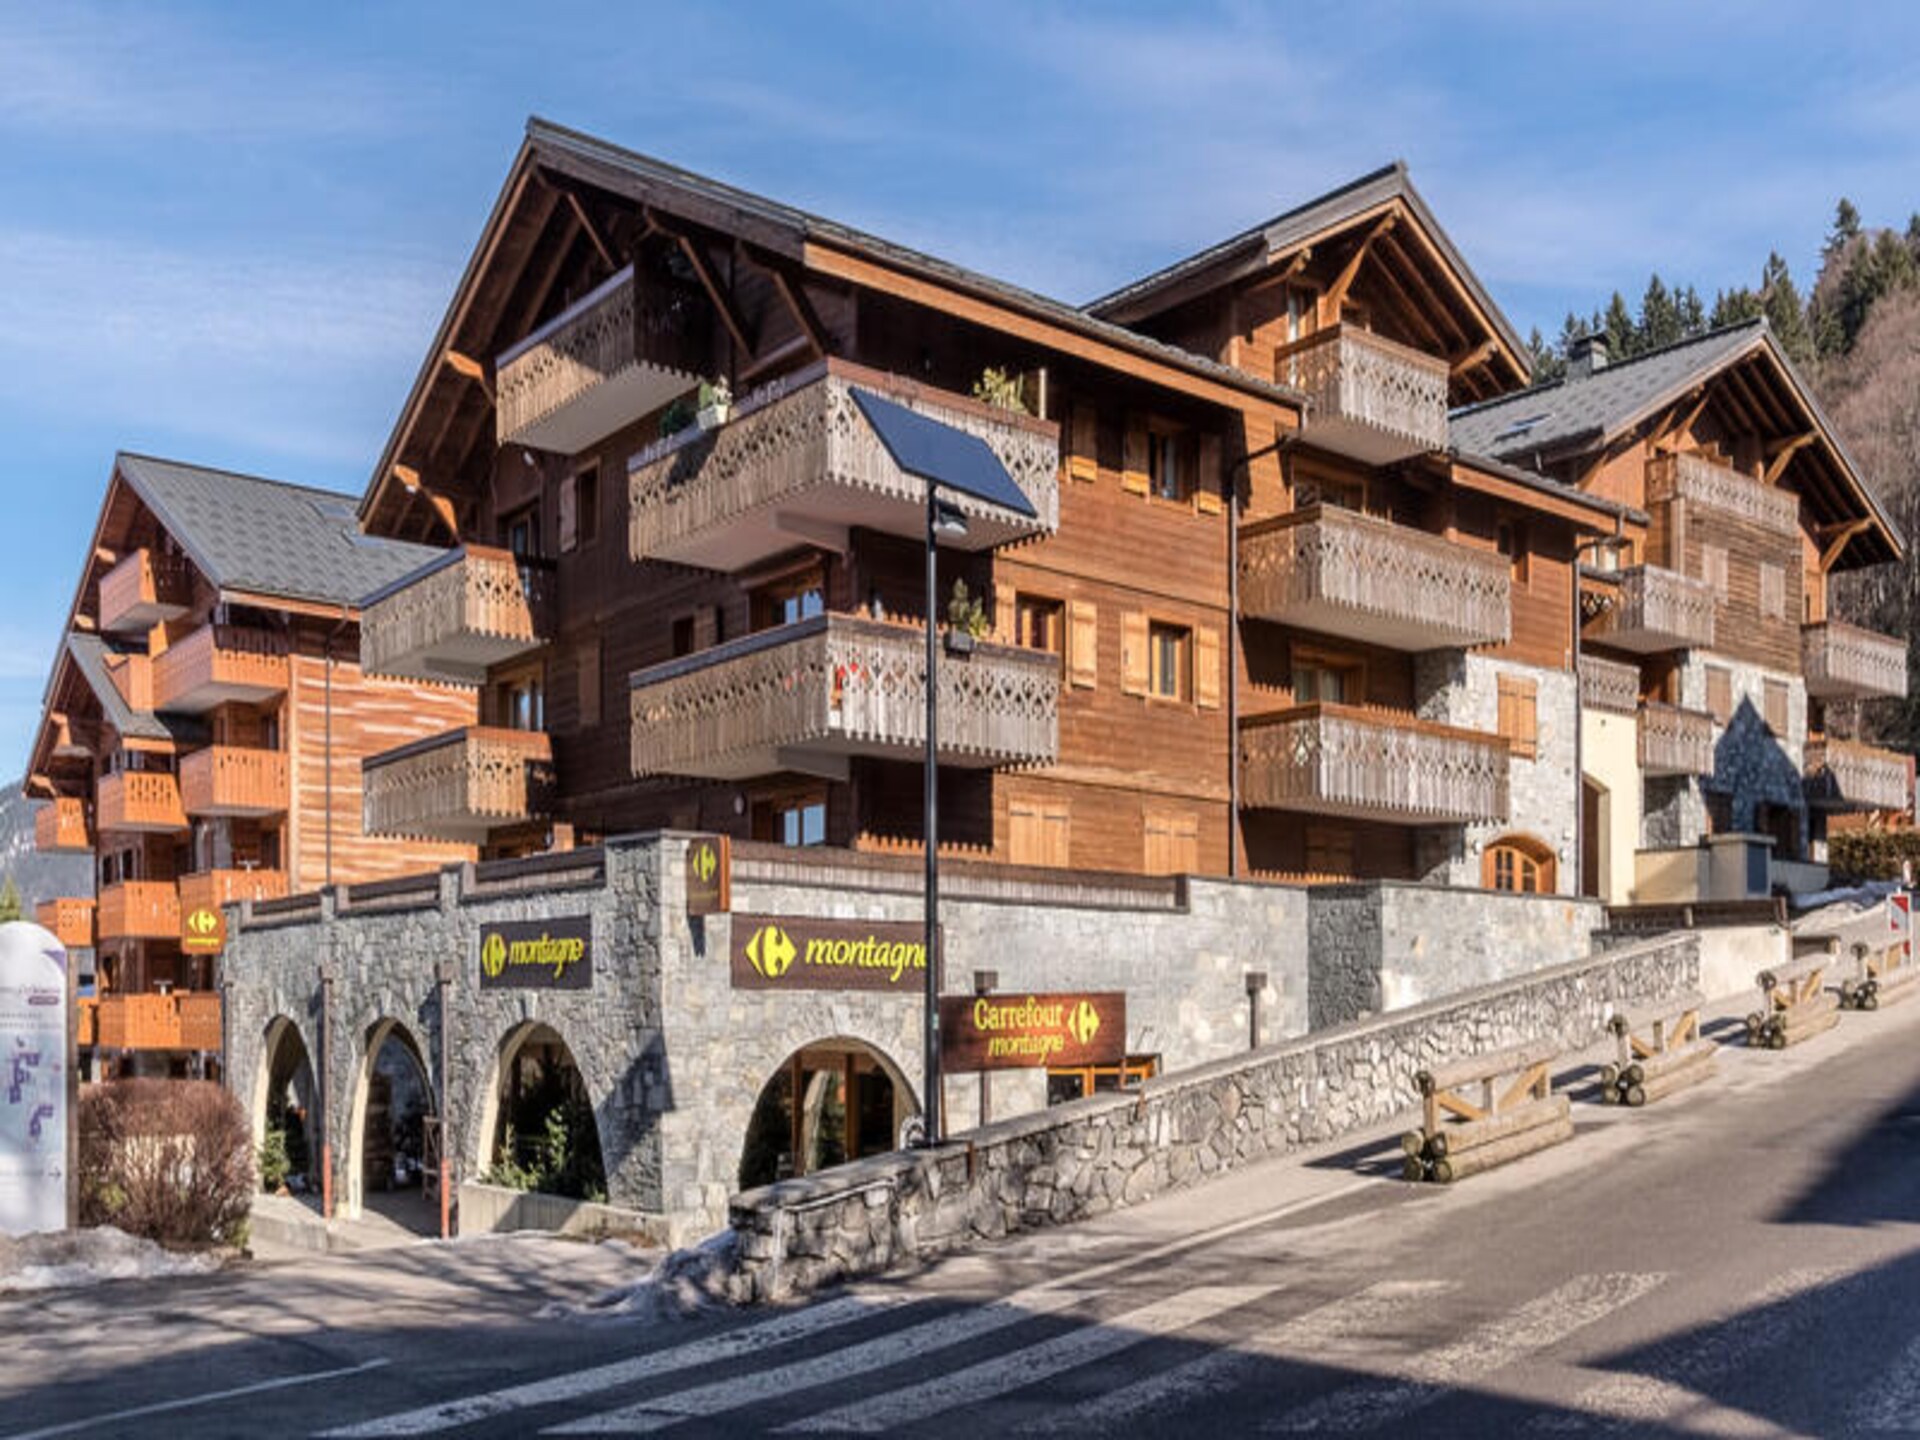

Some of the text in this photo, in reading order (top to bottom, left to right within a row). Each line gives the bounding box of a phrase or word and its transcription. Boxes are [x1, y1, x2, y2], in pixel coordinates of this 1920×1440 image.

[509, 931, 584, 979] montagne
[974, 996, 1063, 1030] Carrefour
[988, 1034, 1064, 1065] montagne
